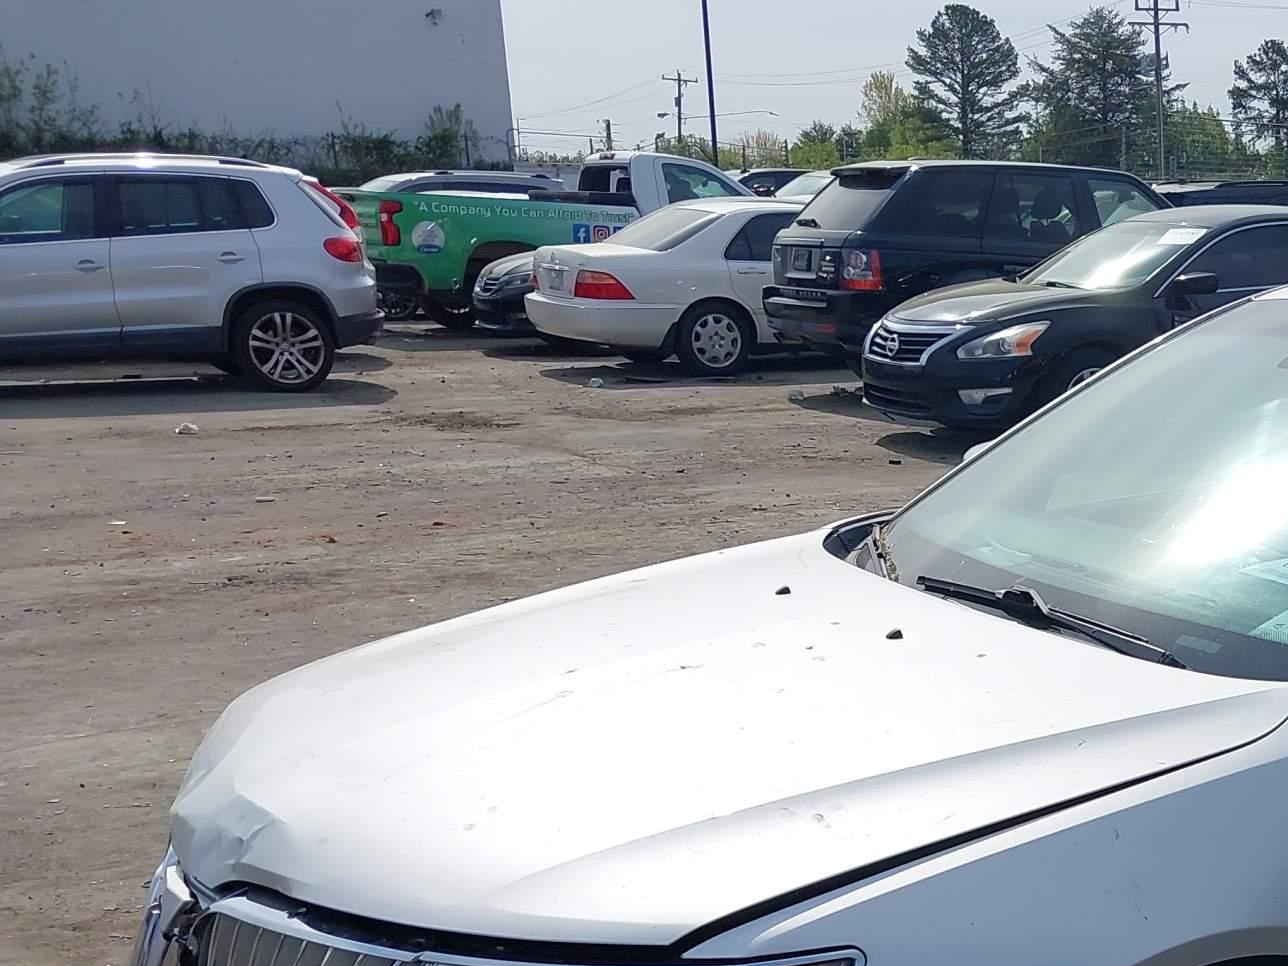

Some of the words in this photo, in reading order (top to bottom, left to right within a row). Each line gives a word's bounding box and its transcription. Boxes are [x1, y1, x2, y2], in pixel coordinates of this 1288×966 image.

[433, 203, 491, 218] Company
[493, 205, 518, 217] You
[522, 207, 544, 218] Can
